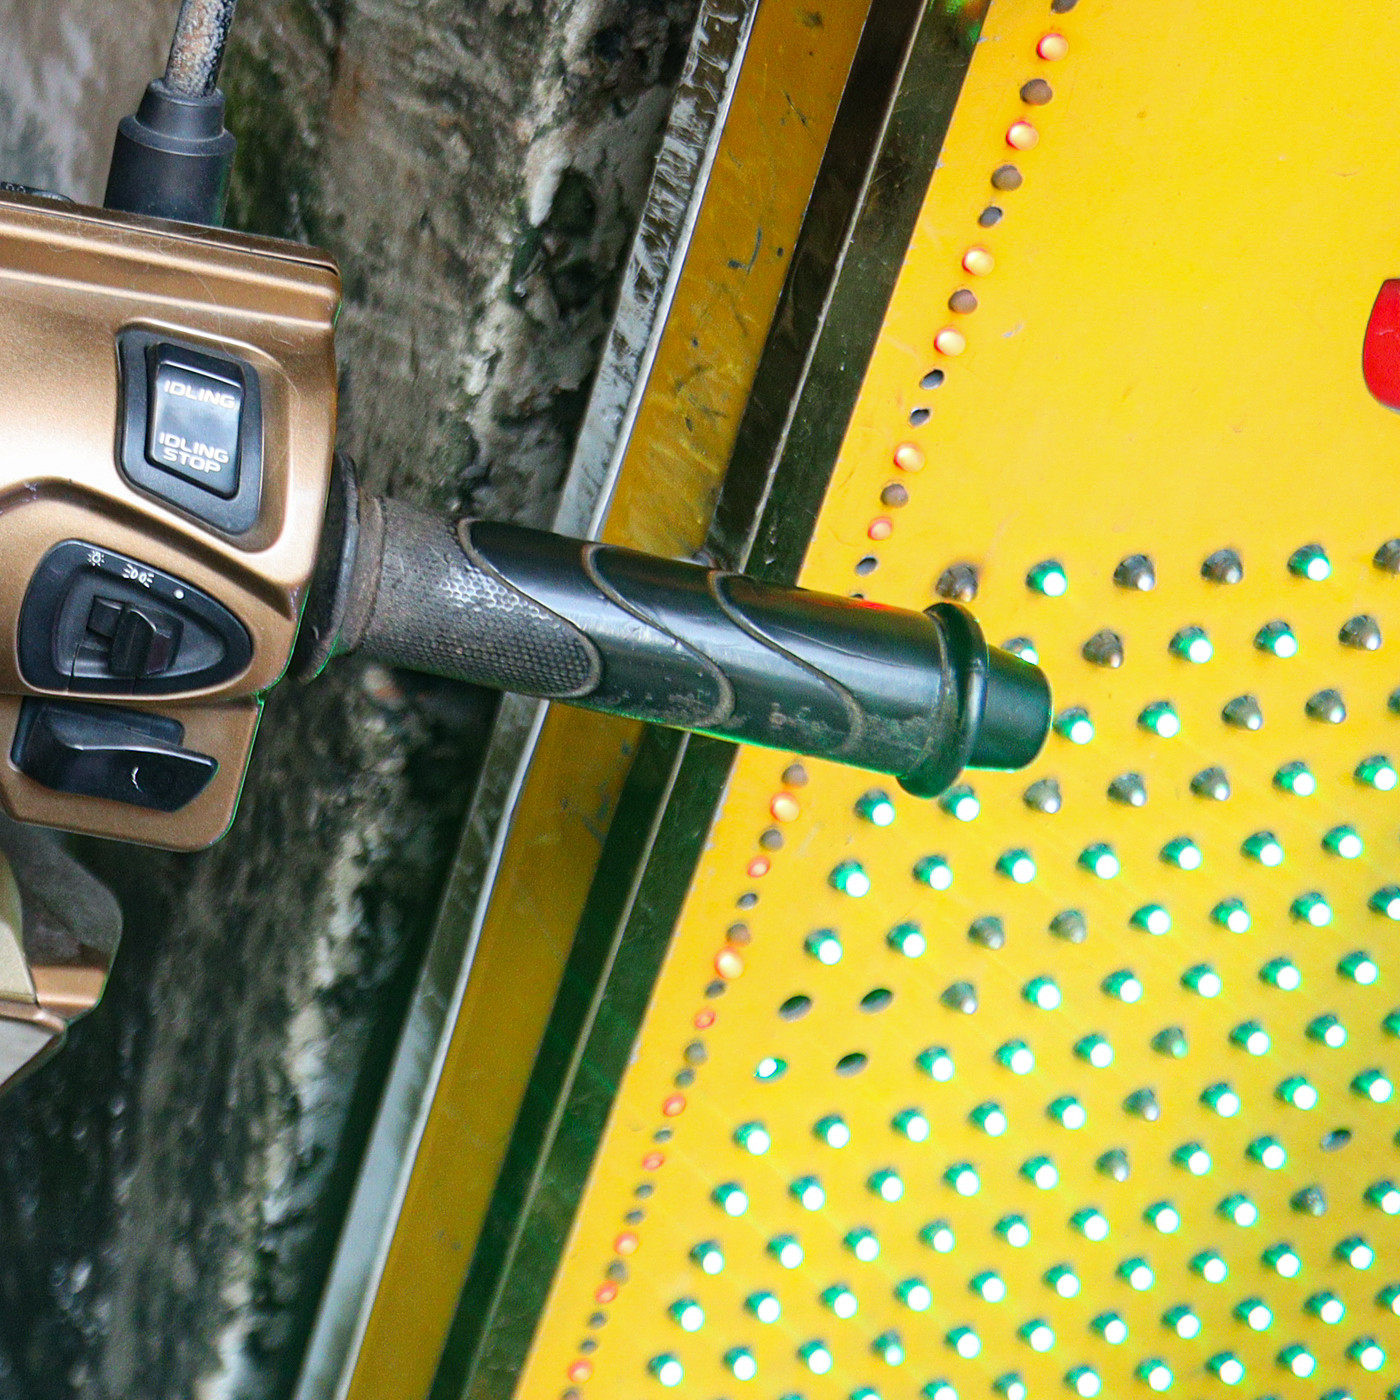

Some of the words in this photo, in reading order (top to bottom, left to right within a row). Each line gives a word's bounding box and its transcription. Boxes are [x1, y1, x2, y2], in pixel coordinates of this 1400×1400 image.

[165, 380, 235, 408] IDLING
[159, 433, 229, 464] IDLING
[164, 448, 220, 473] STOP
